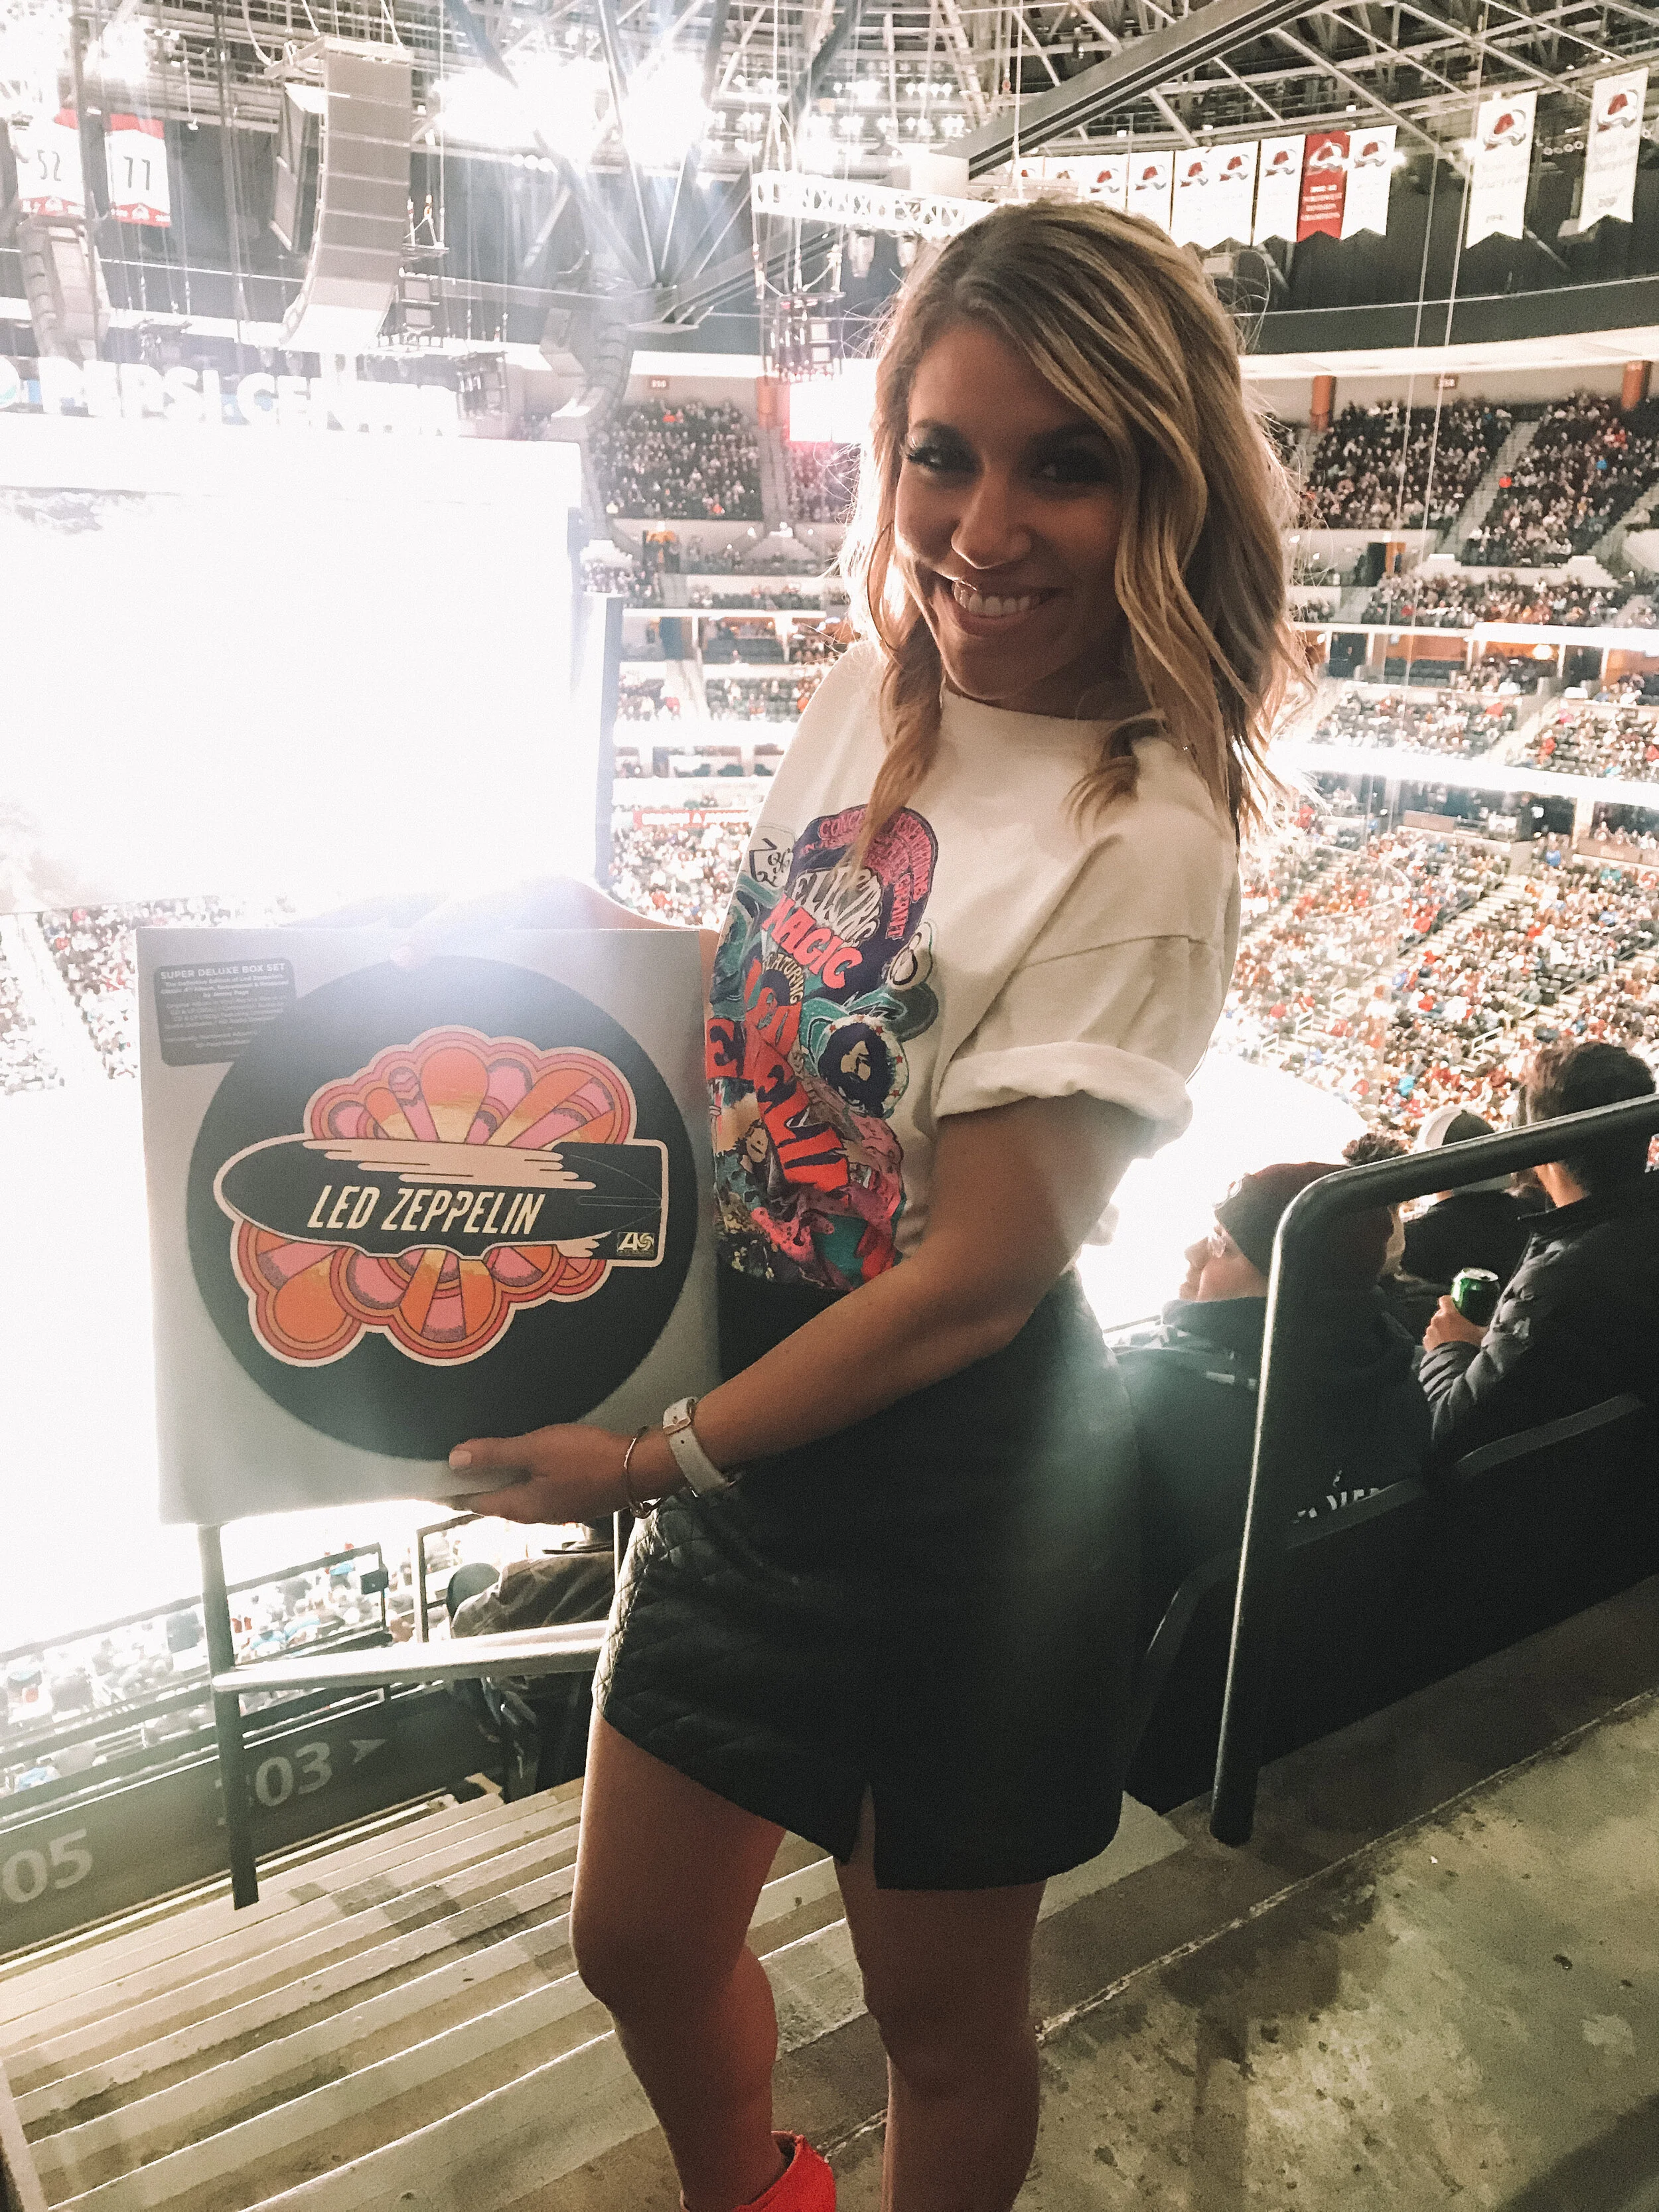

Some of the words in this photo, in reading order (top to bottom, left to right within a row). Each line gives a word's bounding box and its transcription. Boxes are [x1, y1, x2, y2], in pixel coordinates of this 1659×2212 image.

[123, 155, 151, 191] 77
[761, 893, 863, 989] MAGIC
[161, 969, 195, 980] SUPER
[198, 966, 240, 977] DELUXE
[242, 964, 264, 974] BOX
[266, 962, 285, 972] SET
[307, 1185, 380, 1229] LED
[380, 1188, 546, 1234] ZEPPELIN
